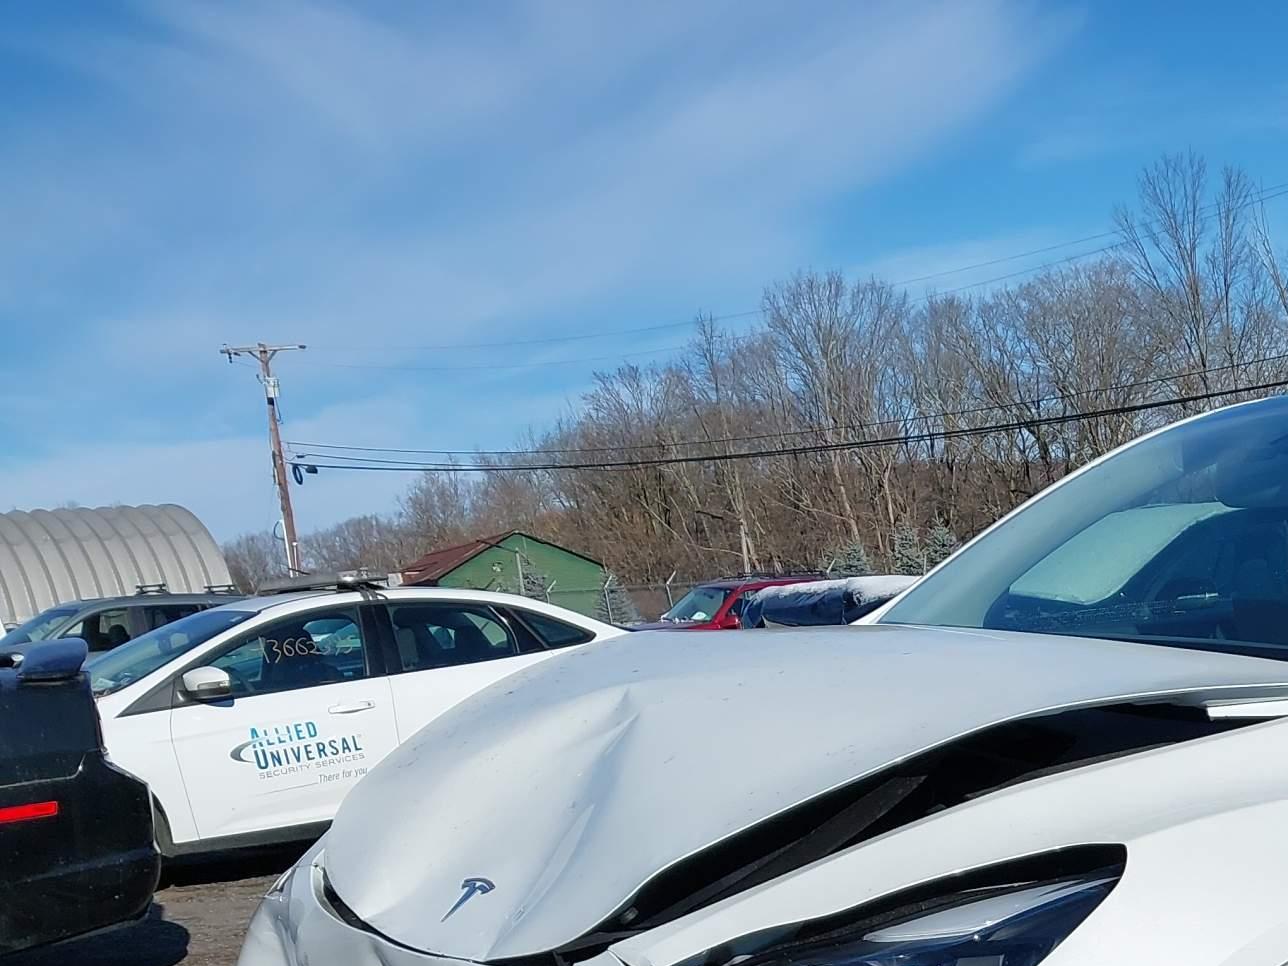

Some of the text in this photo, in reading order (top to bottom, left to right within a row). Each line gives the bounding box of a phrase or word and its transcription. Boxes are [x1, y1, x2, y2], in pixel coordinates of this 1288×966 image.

[250, 722, 317, 748] ALLIED
[253, 735, 363, 770] UNIVERSAL
[259, 752, 366, 780] SECURITY SERVICES
[318, 773, 340, 784] There
[342, 768, 353, 779] for
